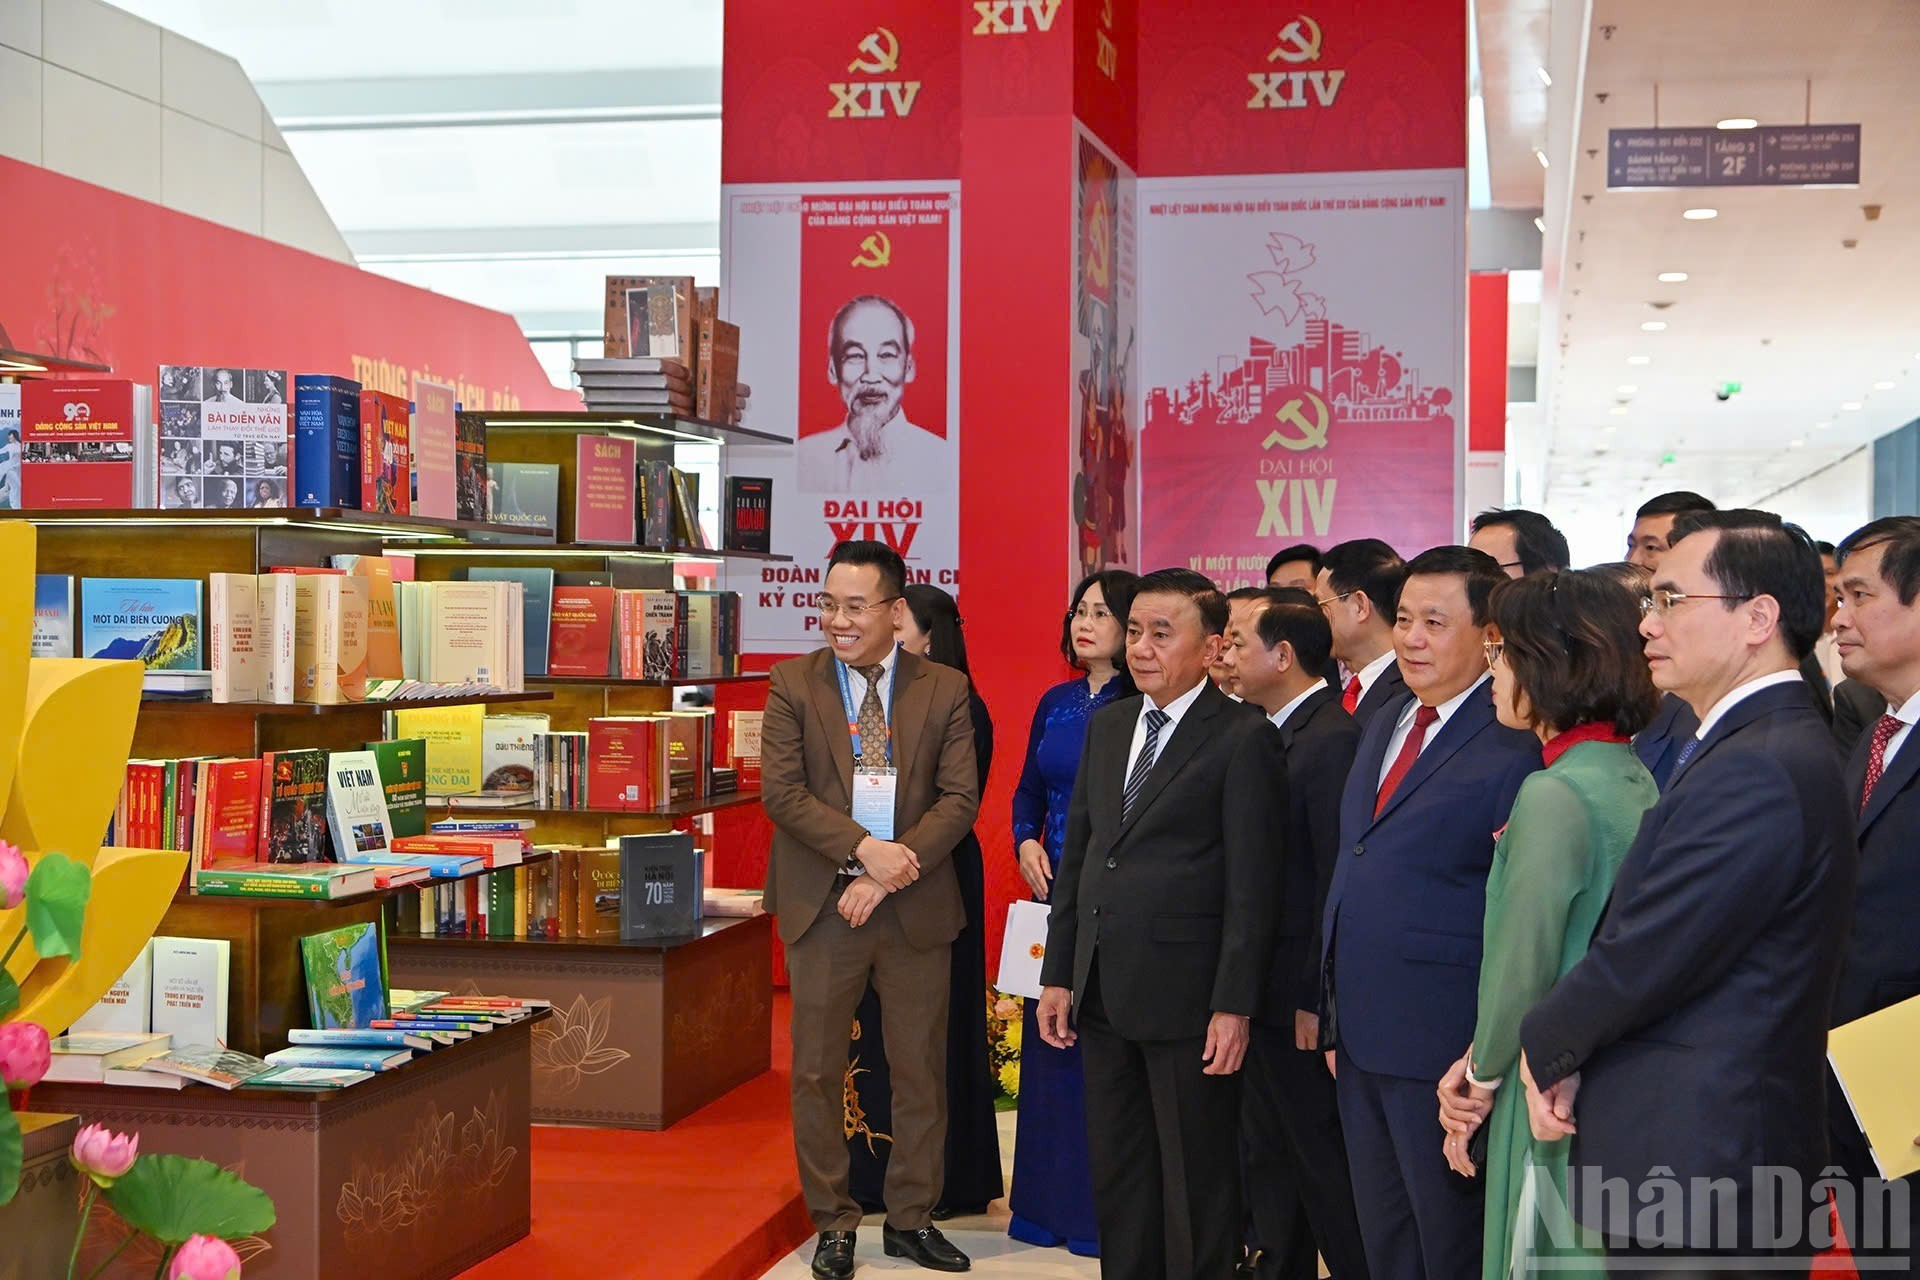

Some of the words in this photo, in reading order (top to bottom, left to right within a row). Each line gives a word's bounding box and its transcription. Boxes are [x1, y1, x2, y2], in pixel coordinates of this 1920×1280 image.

[972, 0, 1061, 36] XIV
[828, 81, 921, 118] XIV
[1247, 70, 1345, 108] XIV
[1722, 157, 1746, 176] 2F
[838, 200, 853, 213] ĐẠI
[872, 200, 887, 212] ĐẠI
[208, 411, 226, 423] BÀI
[229, 411, 256, 424] DIỄN
[259, 413, 281, 425] VĂN
[594, 441, 621, 458] SÁCH
[1260, 458, 1293, 477] ĐẠI
[1300, 456, 1333, 477] HỘI
[534, 514, 547, 522] GIA
[824, 500, 868, 522] ĐẠI
[878, 497, 922, 522] HỘI
[1255, 478, 1337, 537] XIV
[762, 564, 819, 583] ĐOÀN
[1206, 555, 1233, 572] MỘT
[760, 586, 784, 608] KỶ
[336, 767, 355, 789] VIỆT
[356, 769, 374, 788] NAM
[451, 774, 470, 787] ĐẠI
[645, 881, 662, 905] 70
